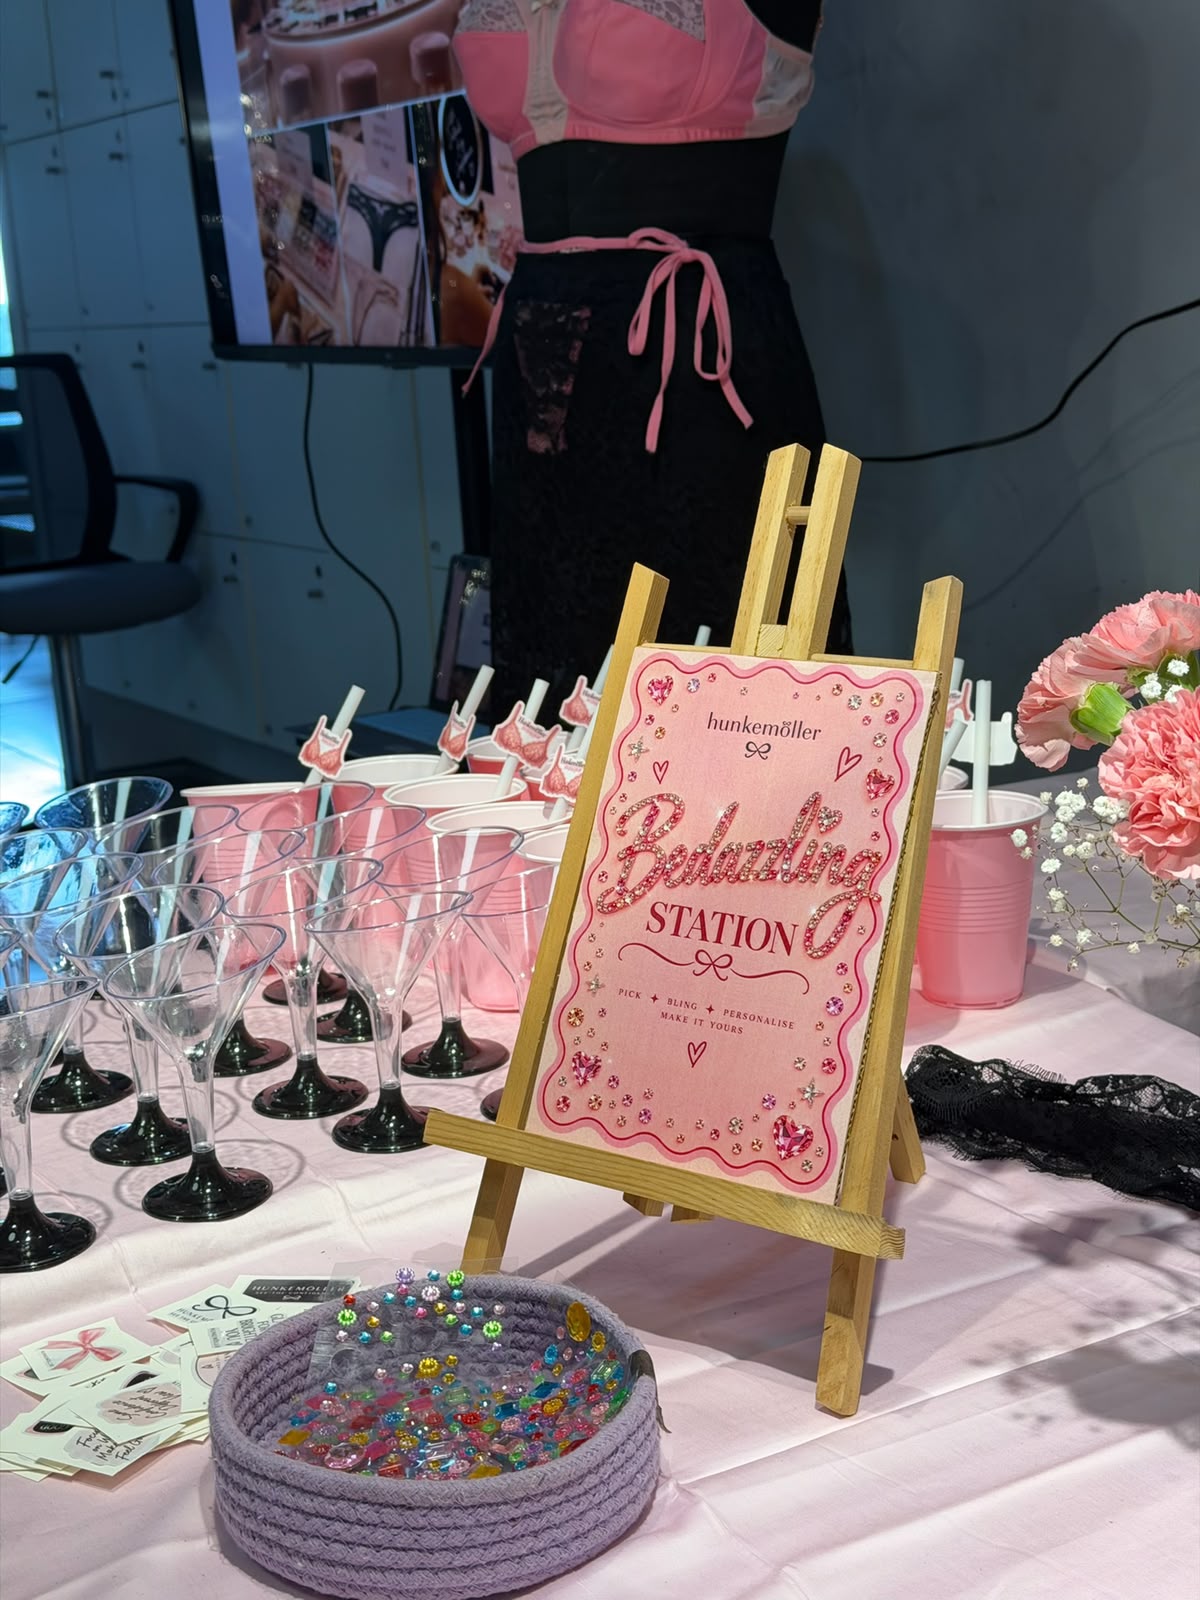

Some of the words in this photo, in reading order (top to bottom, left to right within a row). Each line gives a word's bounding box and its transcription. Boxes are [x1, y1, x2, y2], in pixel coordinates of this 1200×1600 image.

[707, 711, 822, 741] hunkemöller
[596, 791, 883, 960] Bedazzling
[645, 900, 799, 956] STATION
[618, 988, 642, 1000] PICK
[667, 998, 698, 1011] BLING
[723, 1008, 795, 1030] PERSONALISE
[660, 1011, 690, 1024] MAKE
[693, 1017, 704, 1027] IT
[710, 1021, 744, 1035] YOURS
